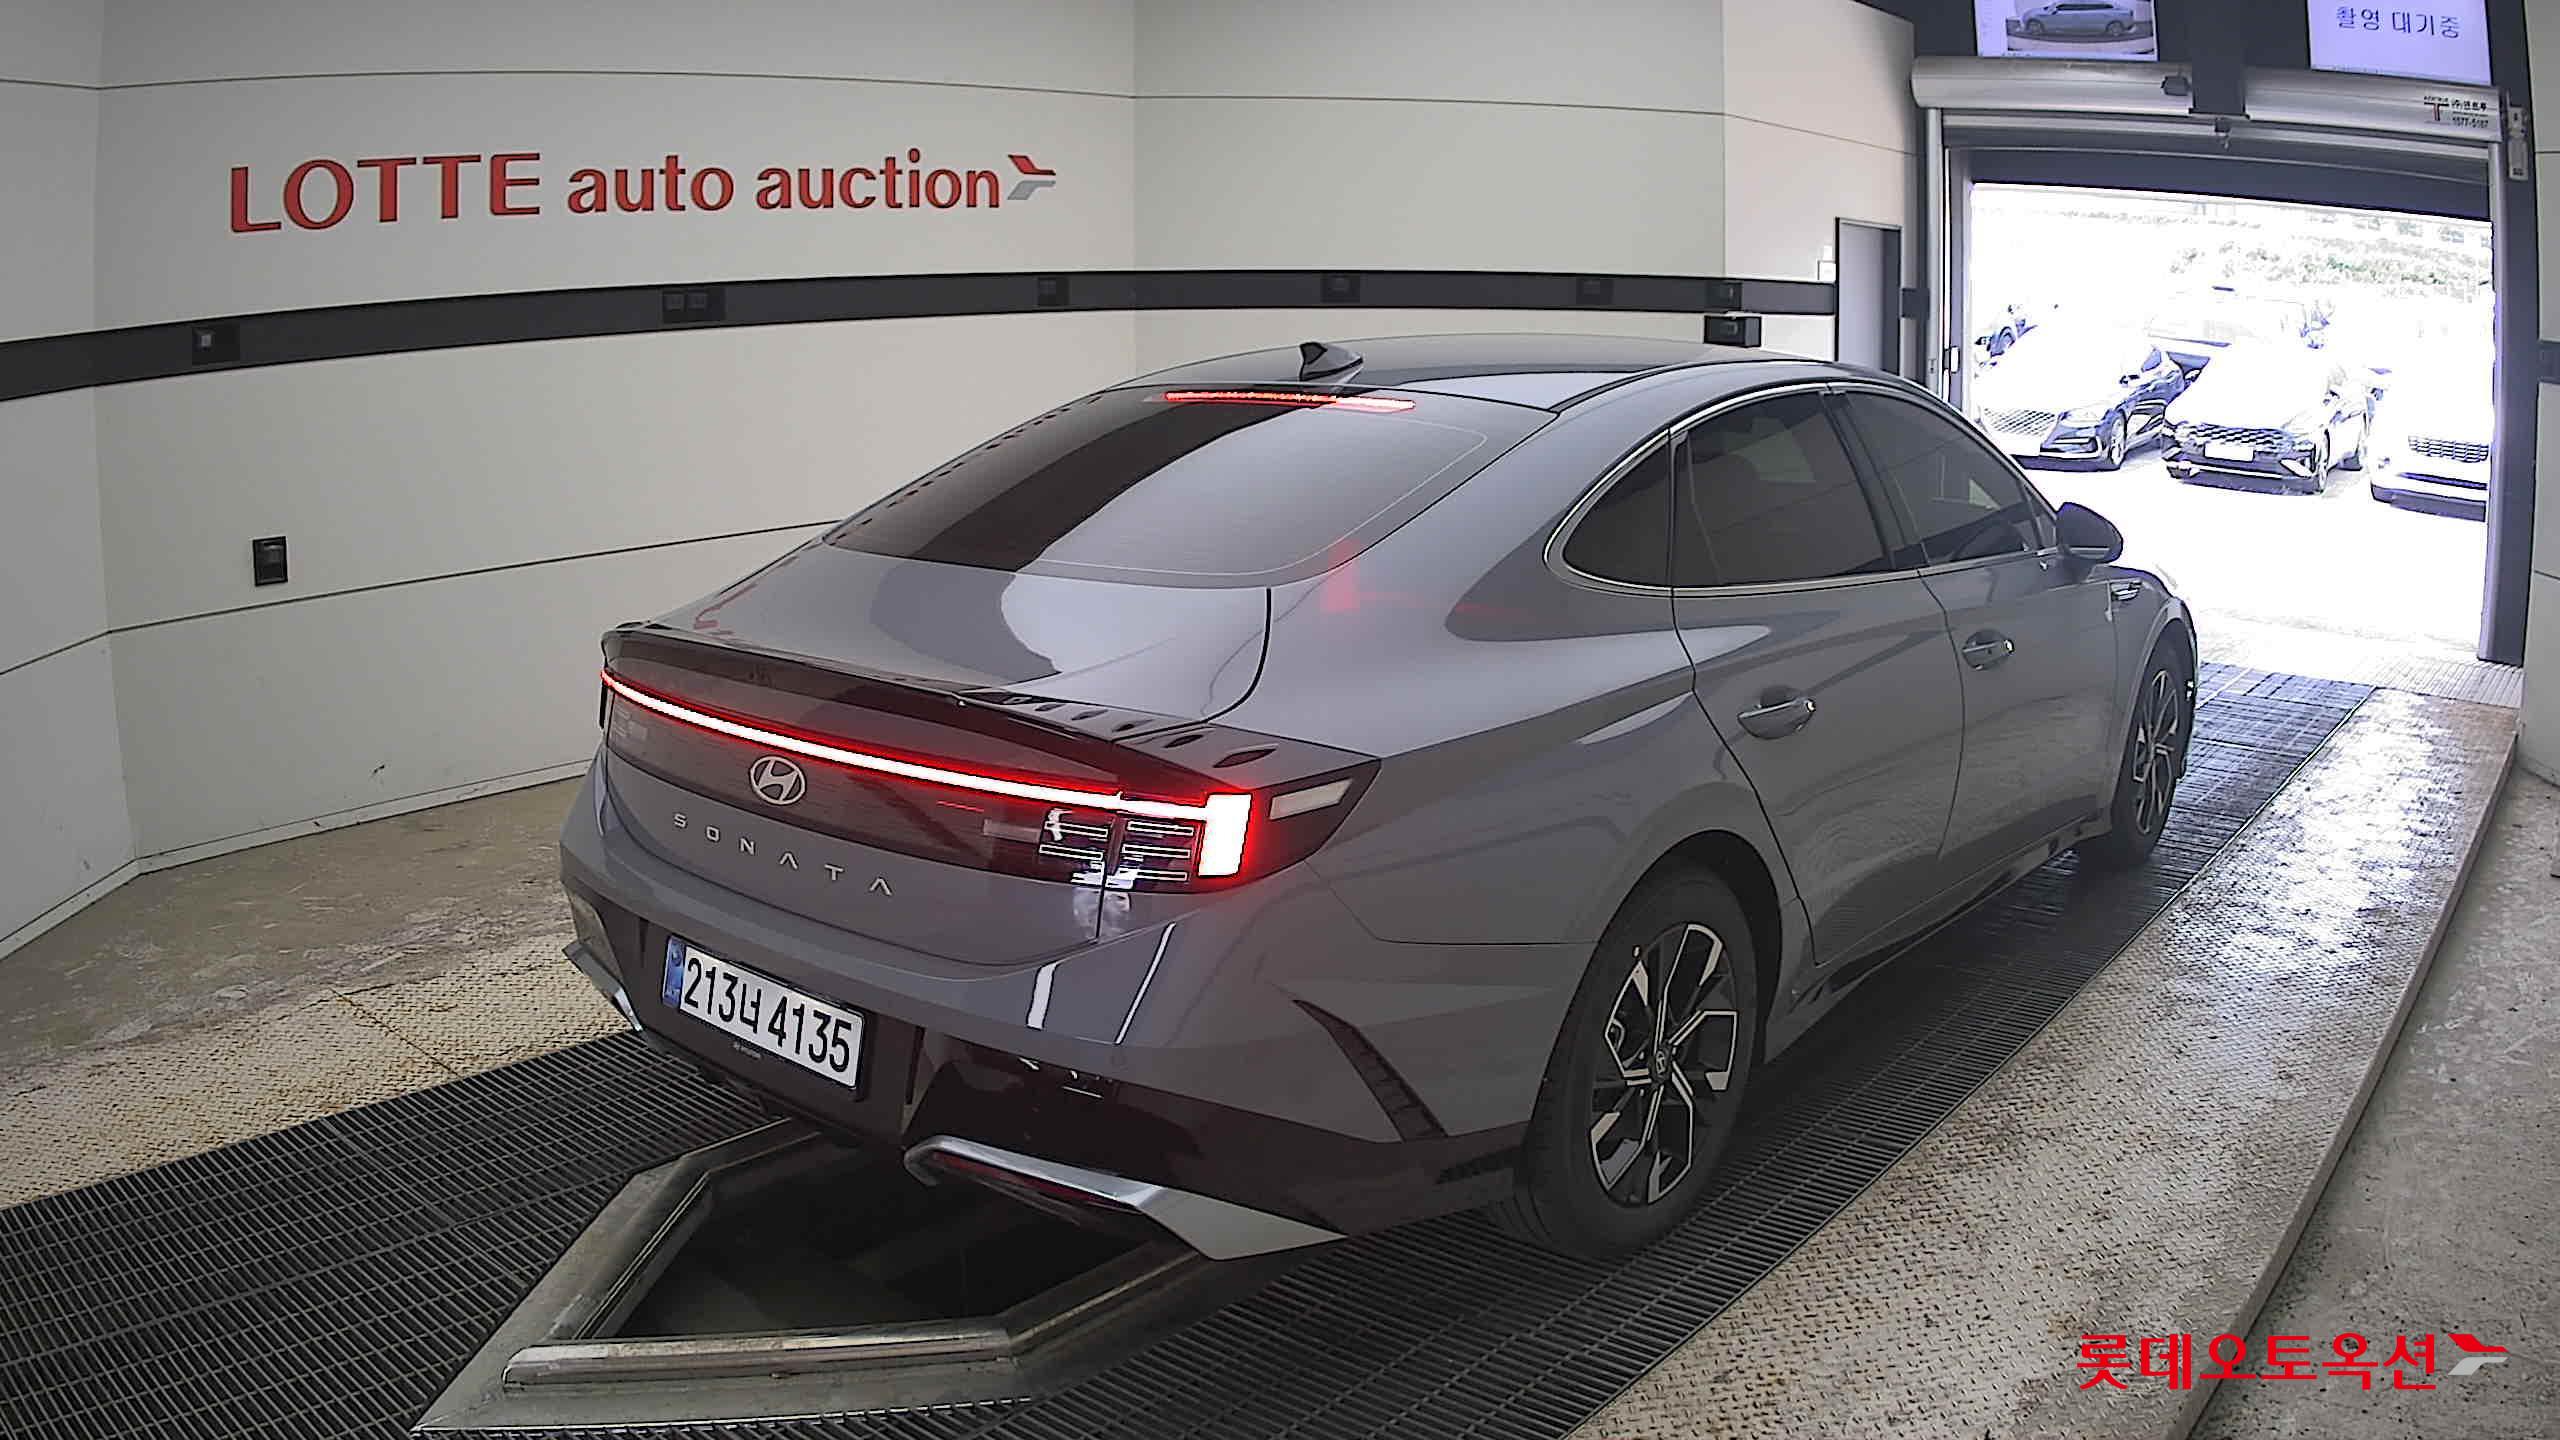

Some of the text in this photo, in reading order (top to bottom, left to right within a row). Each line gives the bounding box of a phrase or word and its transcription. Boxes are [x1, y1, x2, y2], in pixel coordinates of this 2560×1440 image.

[2391, 11, 2460, 39] 대기중
[230, 148, 1001, 234] LOTTE auto auction
[672, 812, 894, 898] SONATA
[683, 957, 853, 1073] 213너 4135
